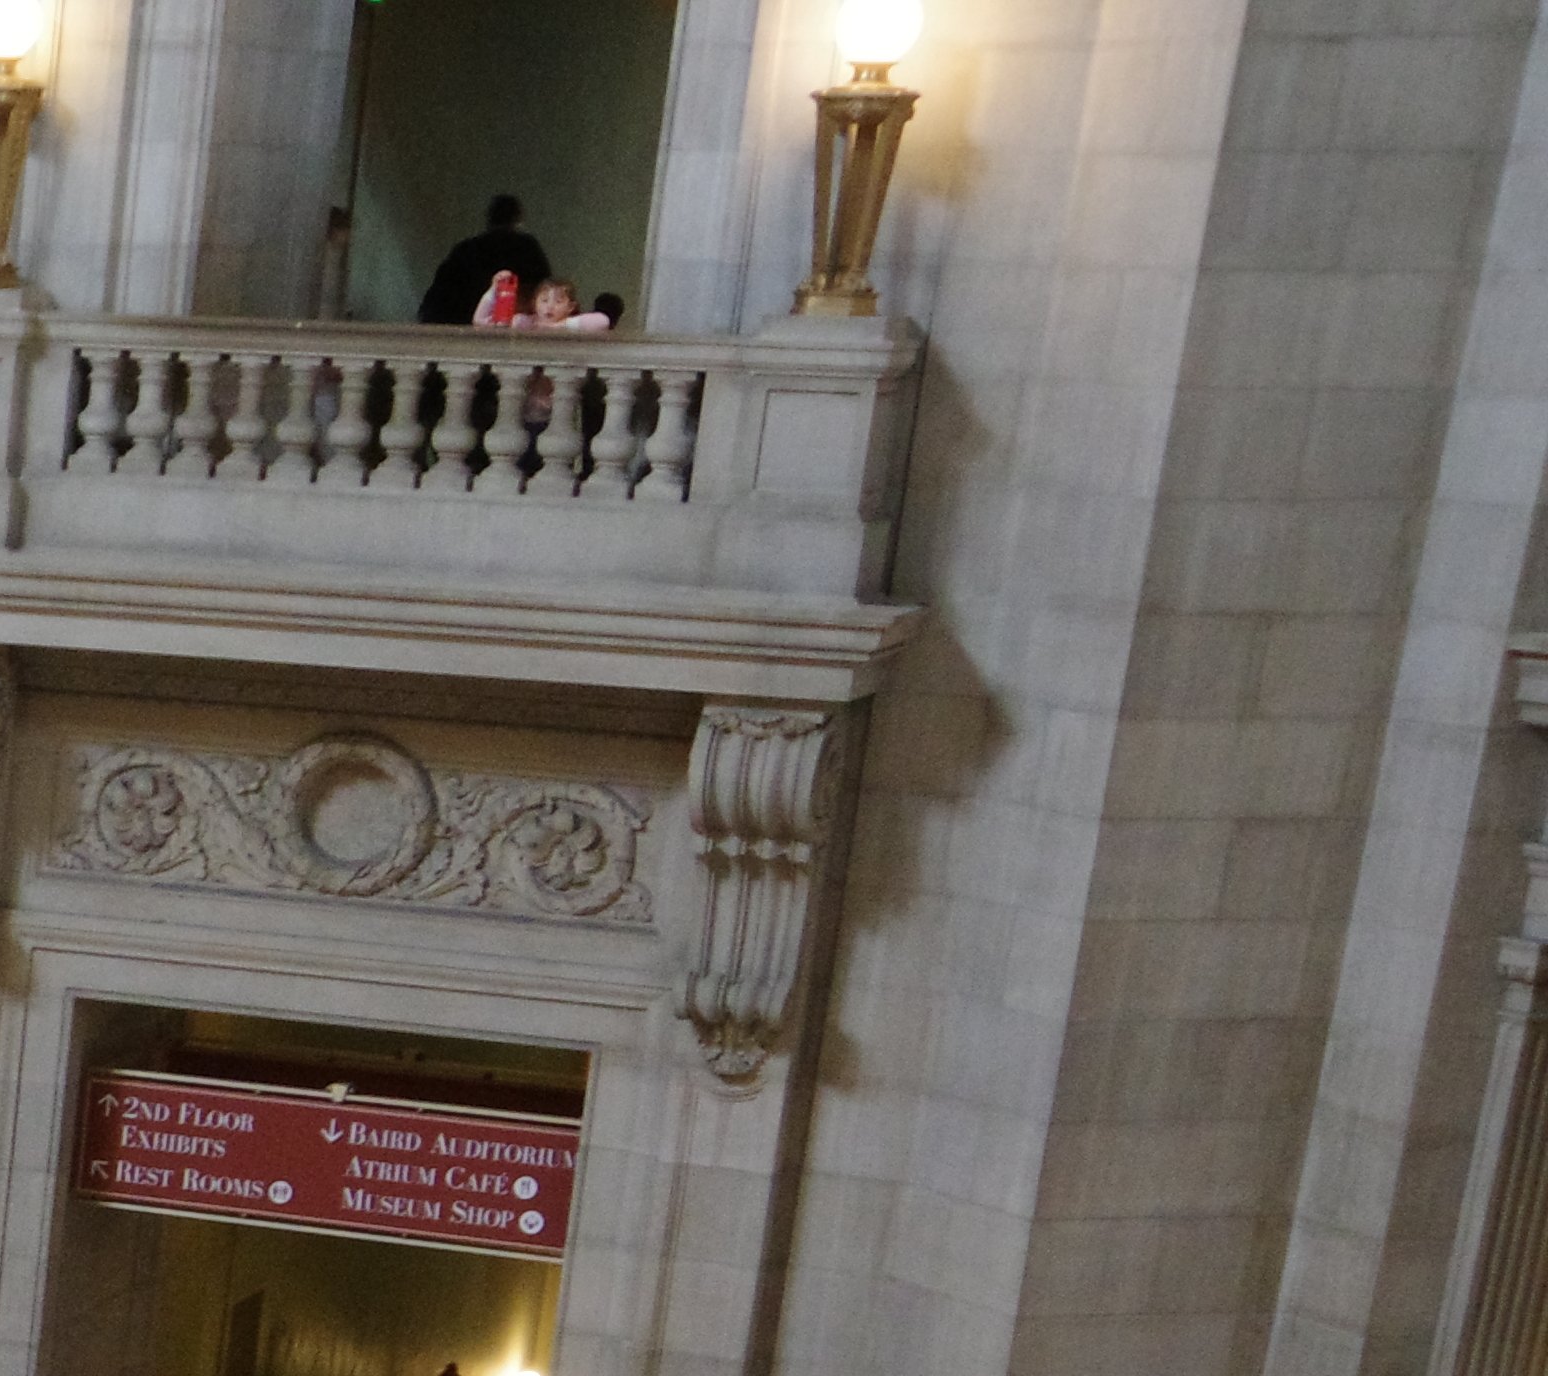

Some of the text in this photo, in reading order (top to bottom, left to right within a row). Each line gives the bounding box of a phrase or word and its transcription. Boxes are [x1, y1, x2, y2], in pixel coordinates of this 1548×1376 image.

[122, 1096, 254, 1132] 2ND FLOOR
[120, 1125, 227, 1158] EXHIBITS
[348, 1122, 422, 1152] BAIRD
[115, 1160, 265, 1199] REST ROOMS
[344, 1156, 509, 1195] ATRIUM CAFÉ
[341, 1187, 515, 1229] MUSEUM SHOP
